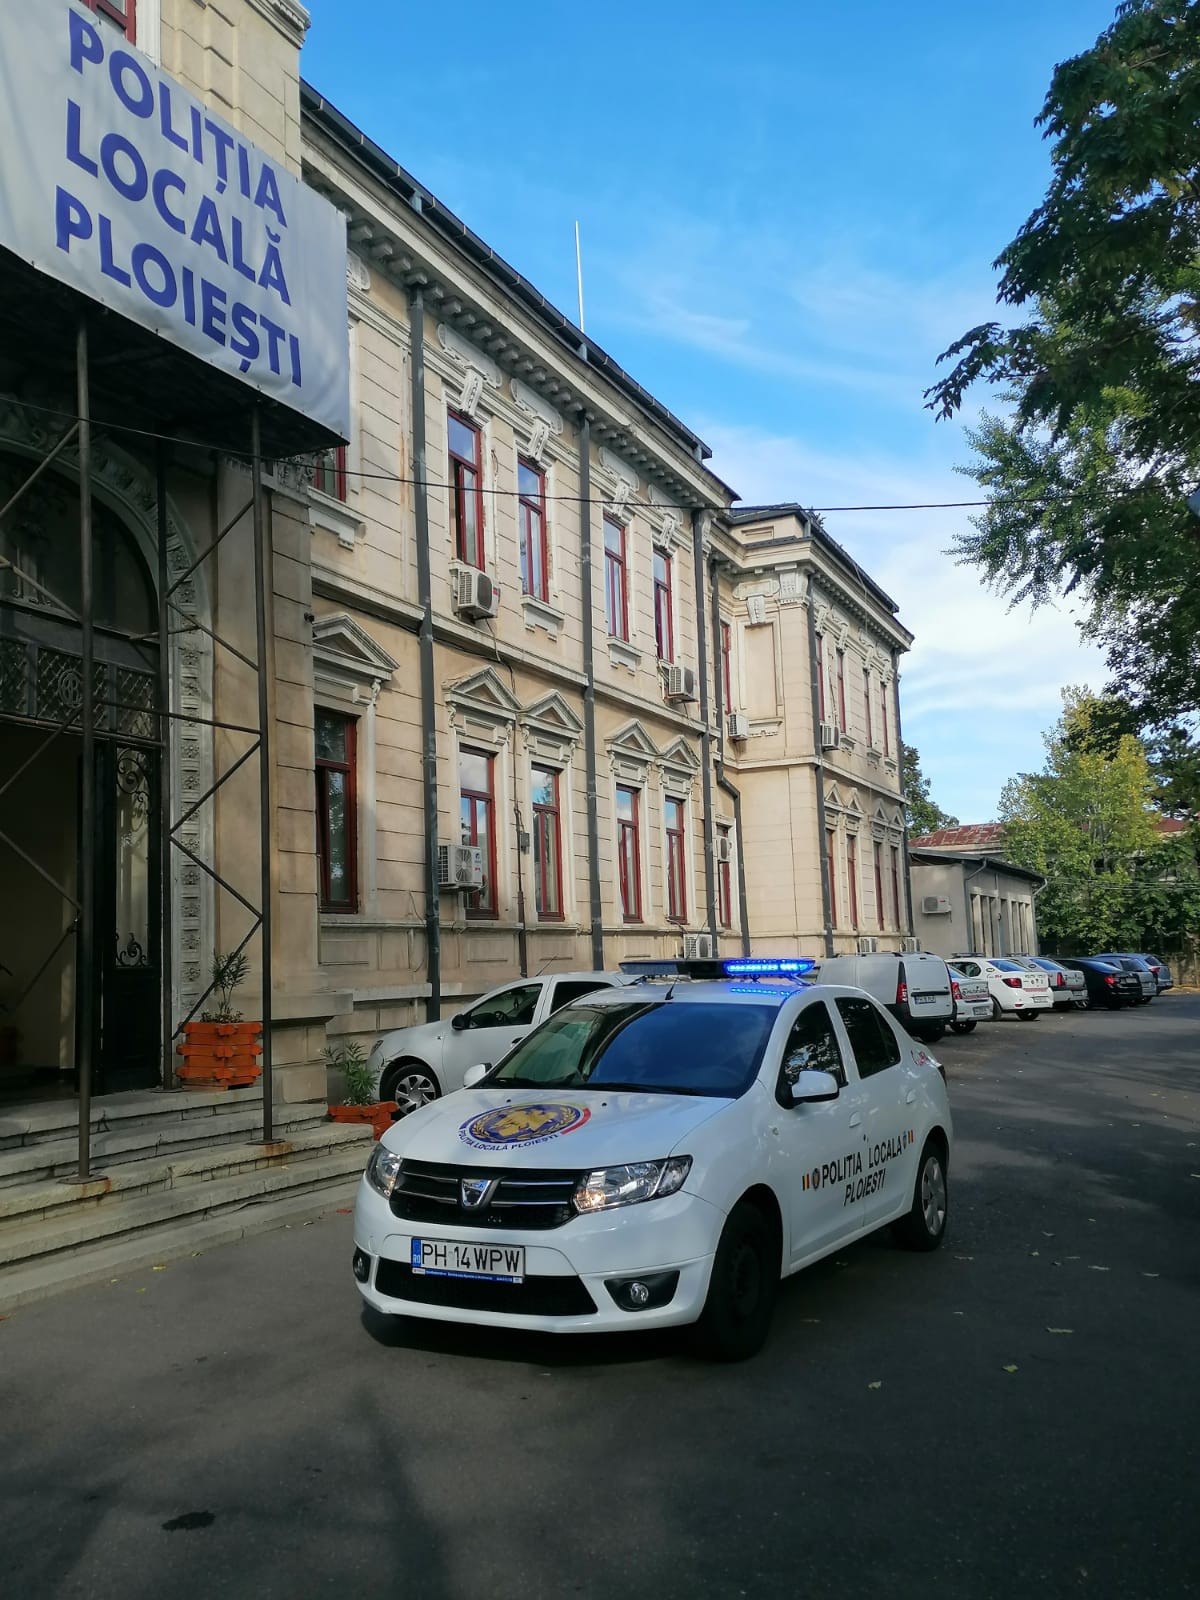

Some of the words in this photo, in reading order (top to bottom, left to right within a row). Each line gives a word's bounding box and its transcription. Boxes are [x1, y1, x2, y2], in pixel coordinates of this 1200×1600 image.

[69, 8, 287, 228] POLIȚIA
[66, 98, 291, 306] LOCALĂ
[55, 185, 302, 387] PLOIEȘTI
[822, 1152, 862, 1188] POLITIA
[869, 1136, 902, 1168] LOCALA
[844, 1168, 886, 1206] PLOIESTI
[422, 1243, 447, 1267] PH
[454, 1246, 471, 1269] 14
[474, 1247, 520, 1272] WPW
